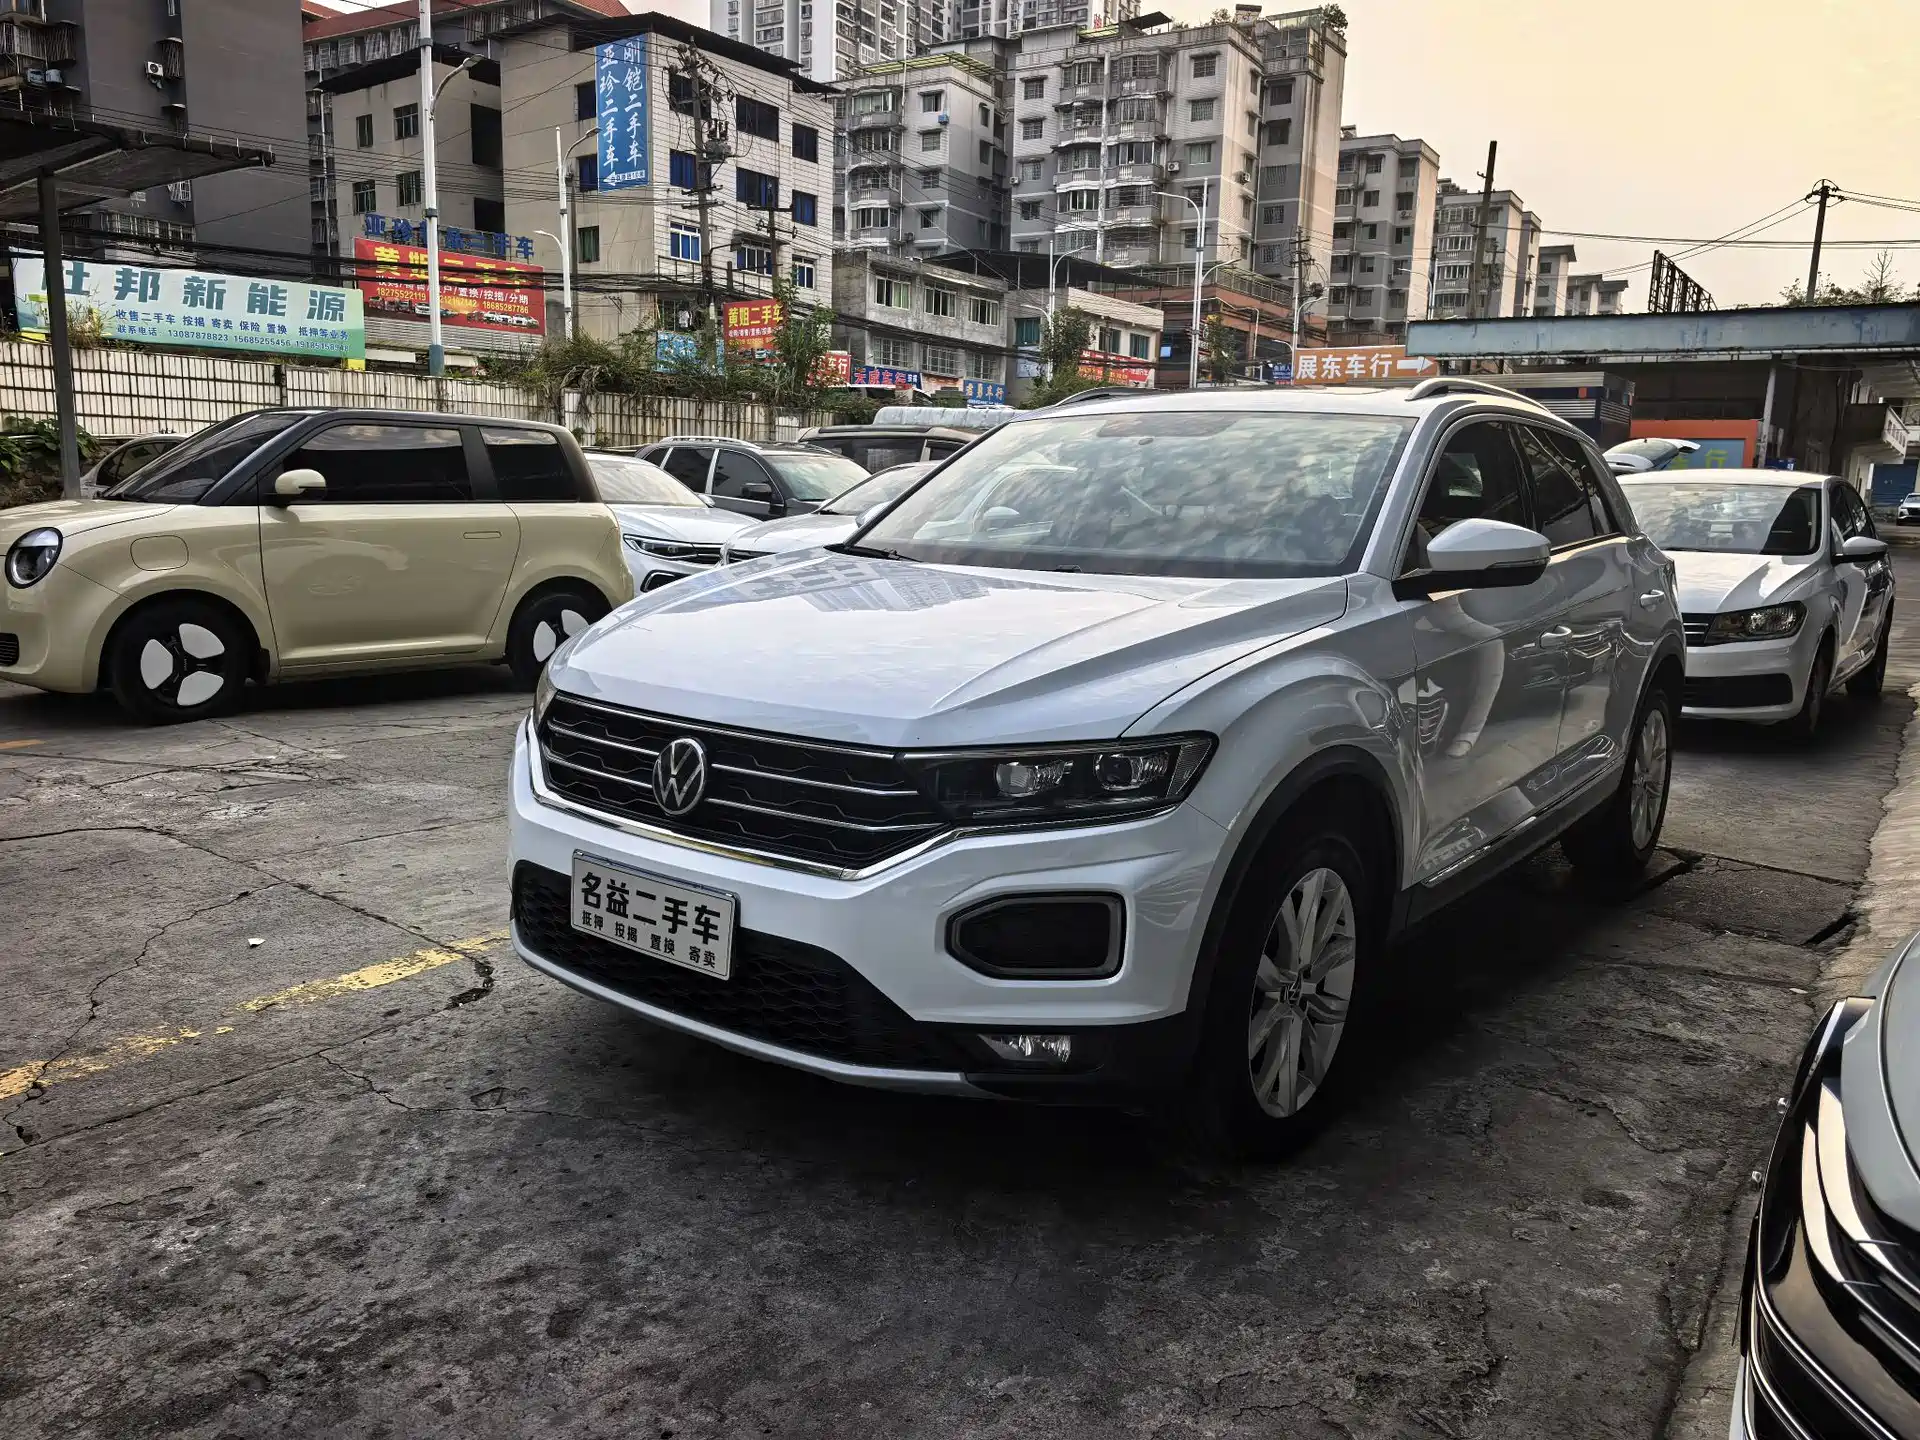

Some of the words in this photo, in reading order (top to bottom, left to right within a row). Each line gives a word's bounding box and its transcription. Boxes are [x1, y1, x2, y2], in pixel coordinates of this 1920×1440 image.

[600, 45, 620, 170] 亚珍二手车
[116, 309, 176, 325] 收售二手车
[240, 320, 260, 332] 保险
[267, 323, 287, 335] 置换
[1296, 353, 1392, 379] 展东车行
[581, 872, 720, 945] 名益二手车
[582, 910, 603, 931] 抵押
[615, 921, 637, 943] 按揭
[650, 933, 675, 956] 置换
[689, 945, 715, 968] 寄卖
